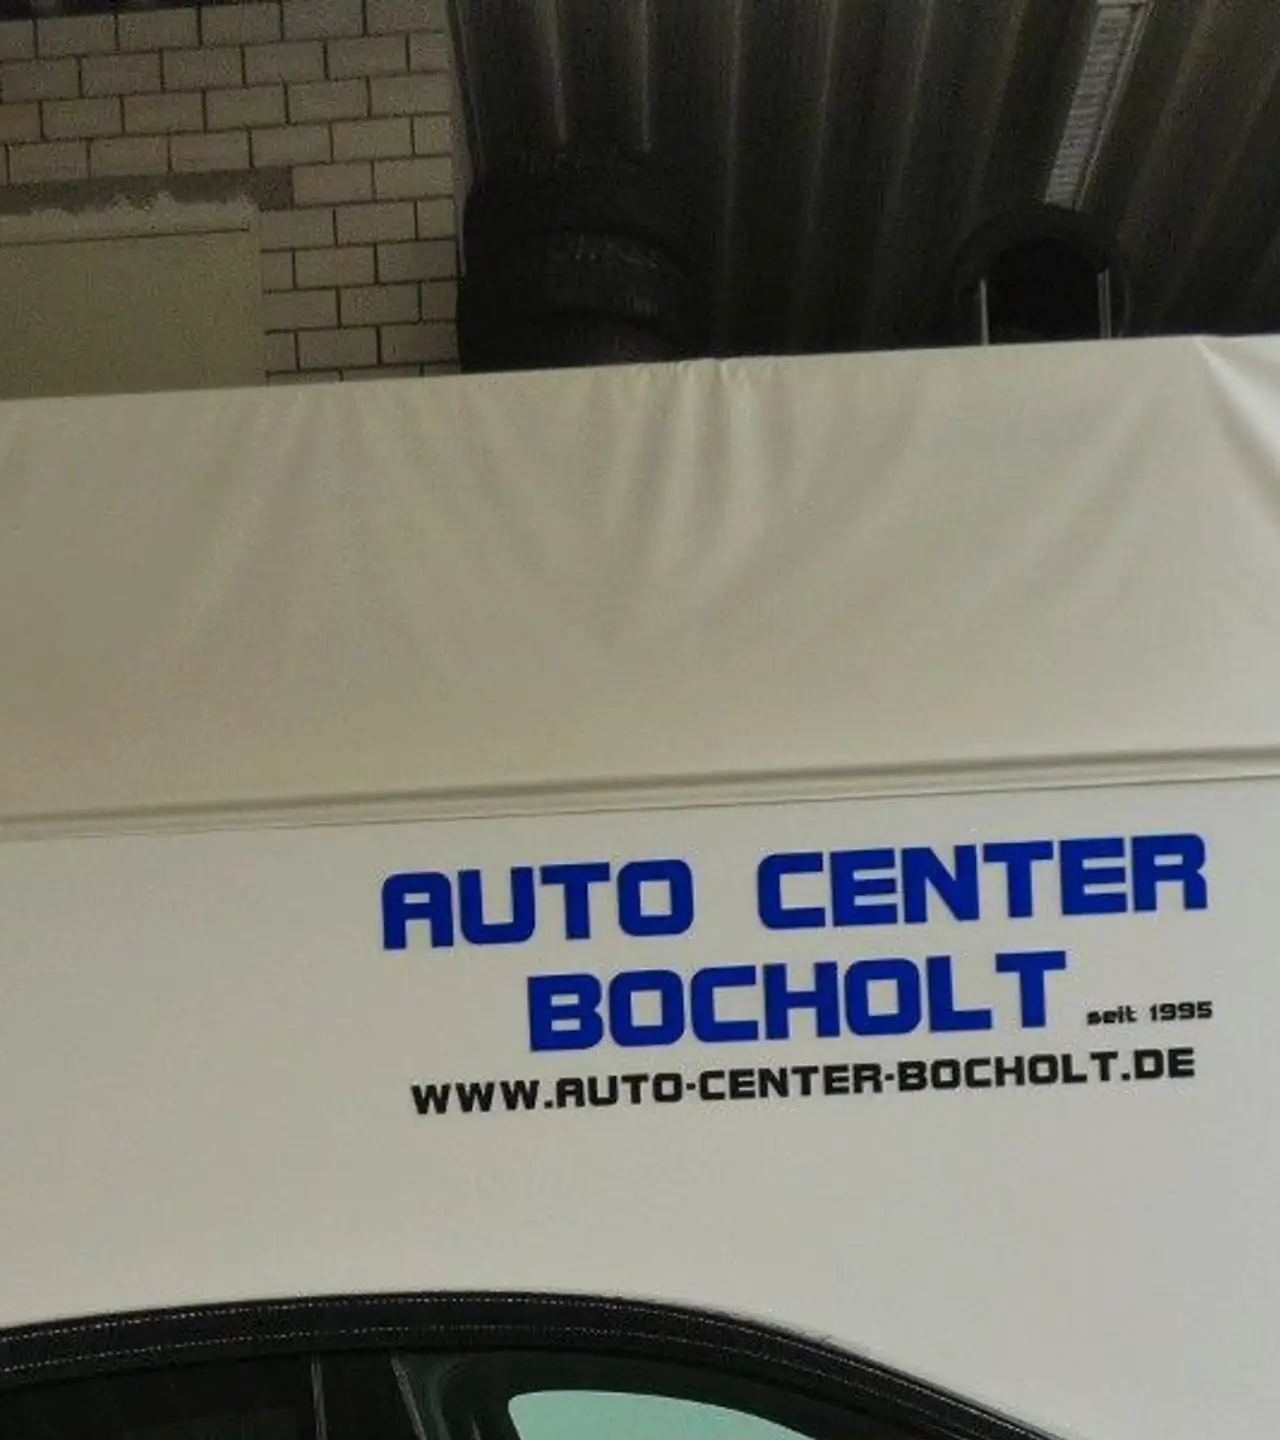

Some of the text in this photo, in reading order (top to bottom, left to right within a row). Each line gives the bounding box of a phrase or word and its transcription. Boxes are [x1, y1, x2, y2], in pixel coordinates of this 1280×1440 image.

[380, 833, 1208, 951] AUTO CENTER
[526, 950, 1213, 1053] BOCHOLT seit 1995
[410, 1047, 1196, 1116] WWW.AUTO-CENTER-BOCHOLT.DE
